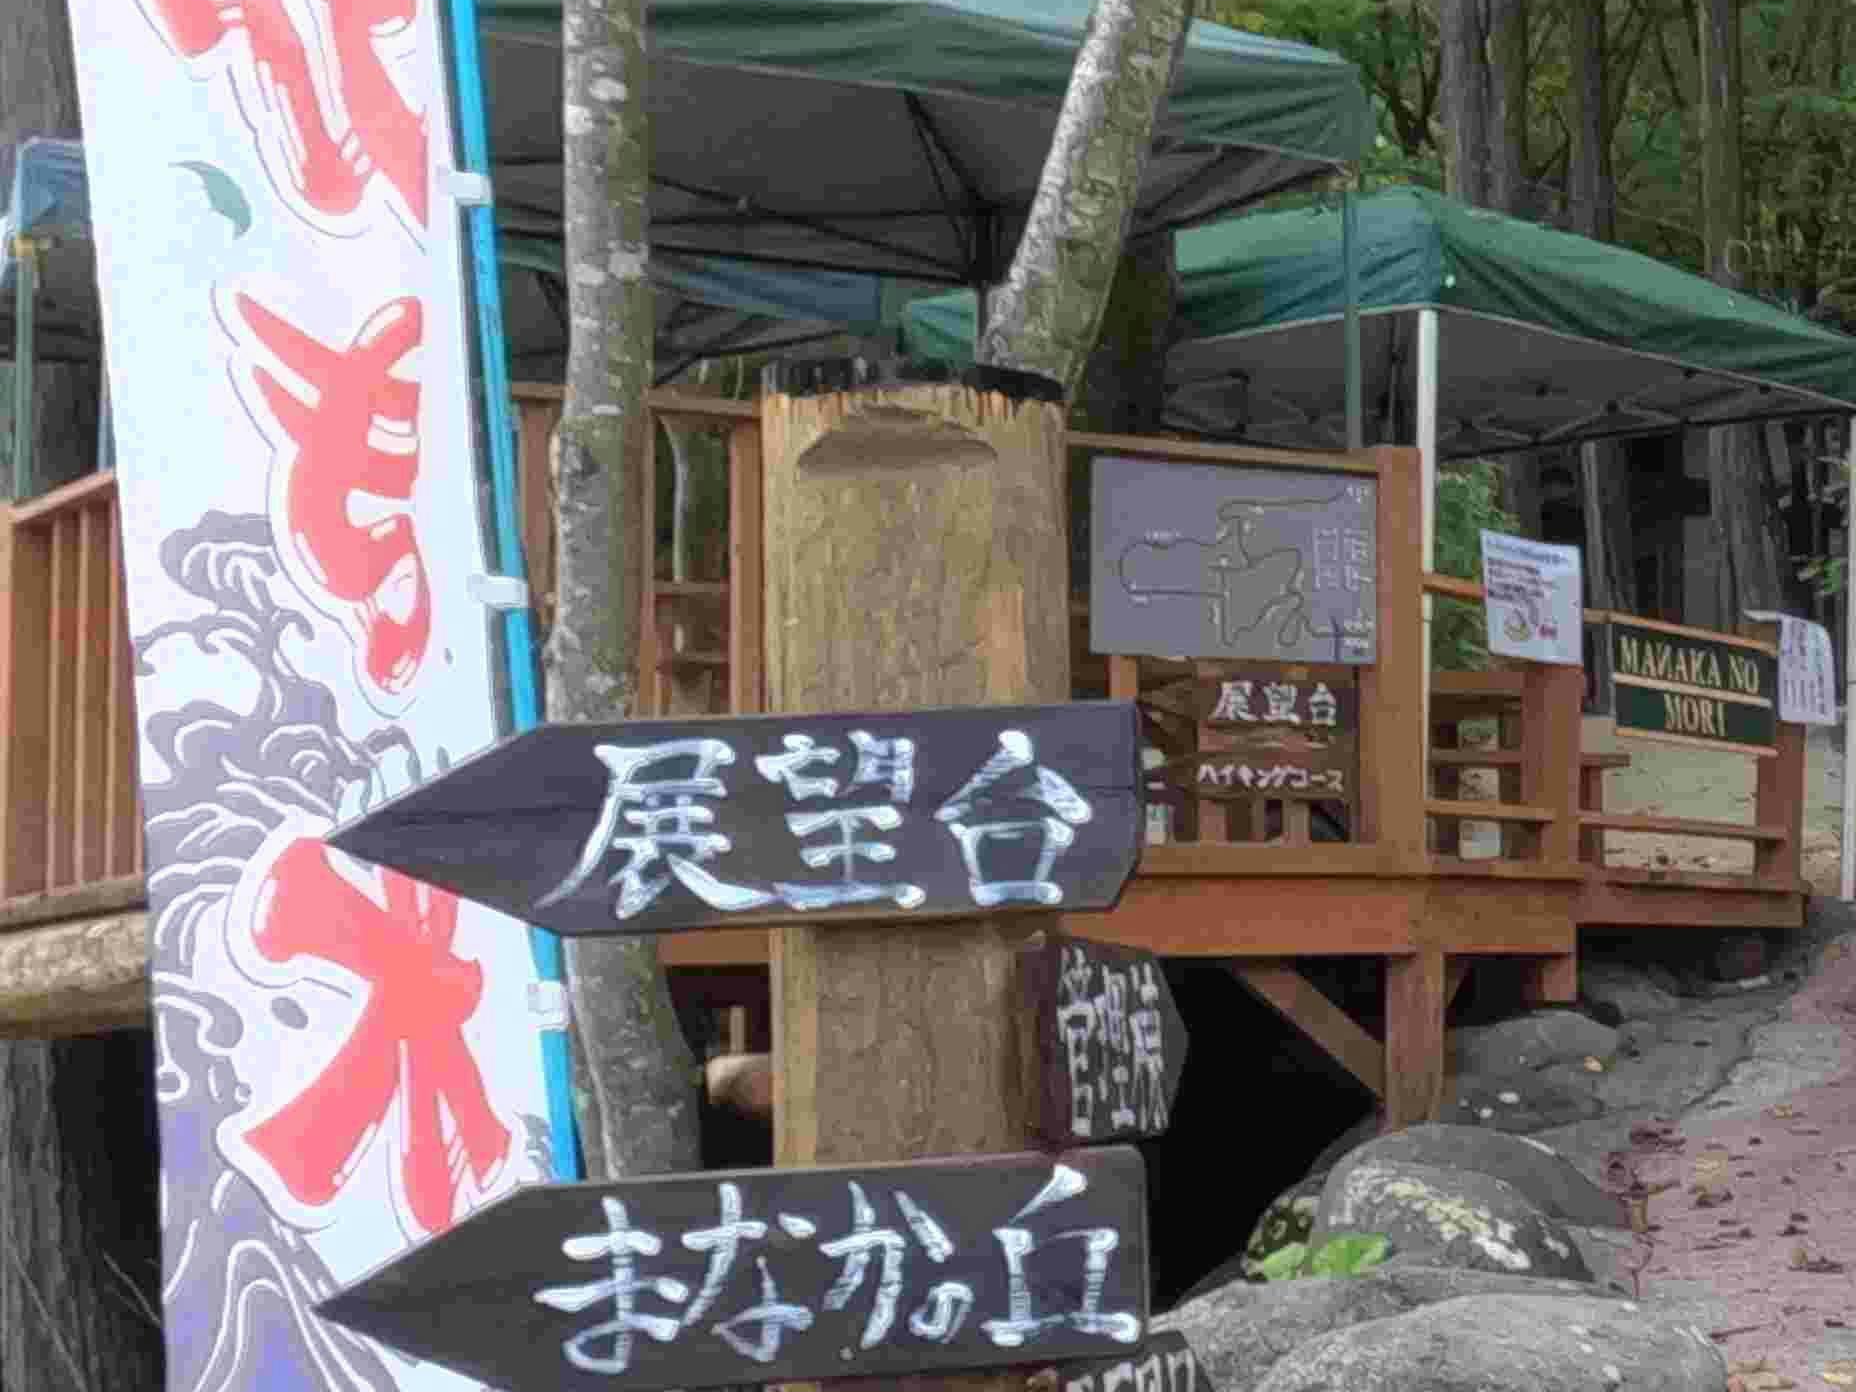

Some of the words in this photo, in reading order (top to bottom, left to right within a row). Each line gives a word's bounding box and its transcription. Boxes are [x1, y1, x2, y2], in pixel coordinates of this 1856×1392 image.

[1728, 654, 1761, 695] NO
[1207, 680, 1338, 727] 展望台
[1663, 692, 1726, 737] MORI
[1196, 763, 1345, 792] ハイキングコース
[534, 729, 1094, 919] 展望台
[531, 1163, 1142, 1375] まなかの丘
